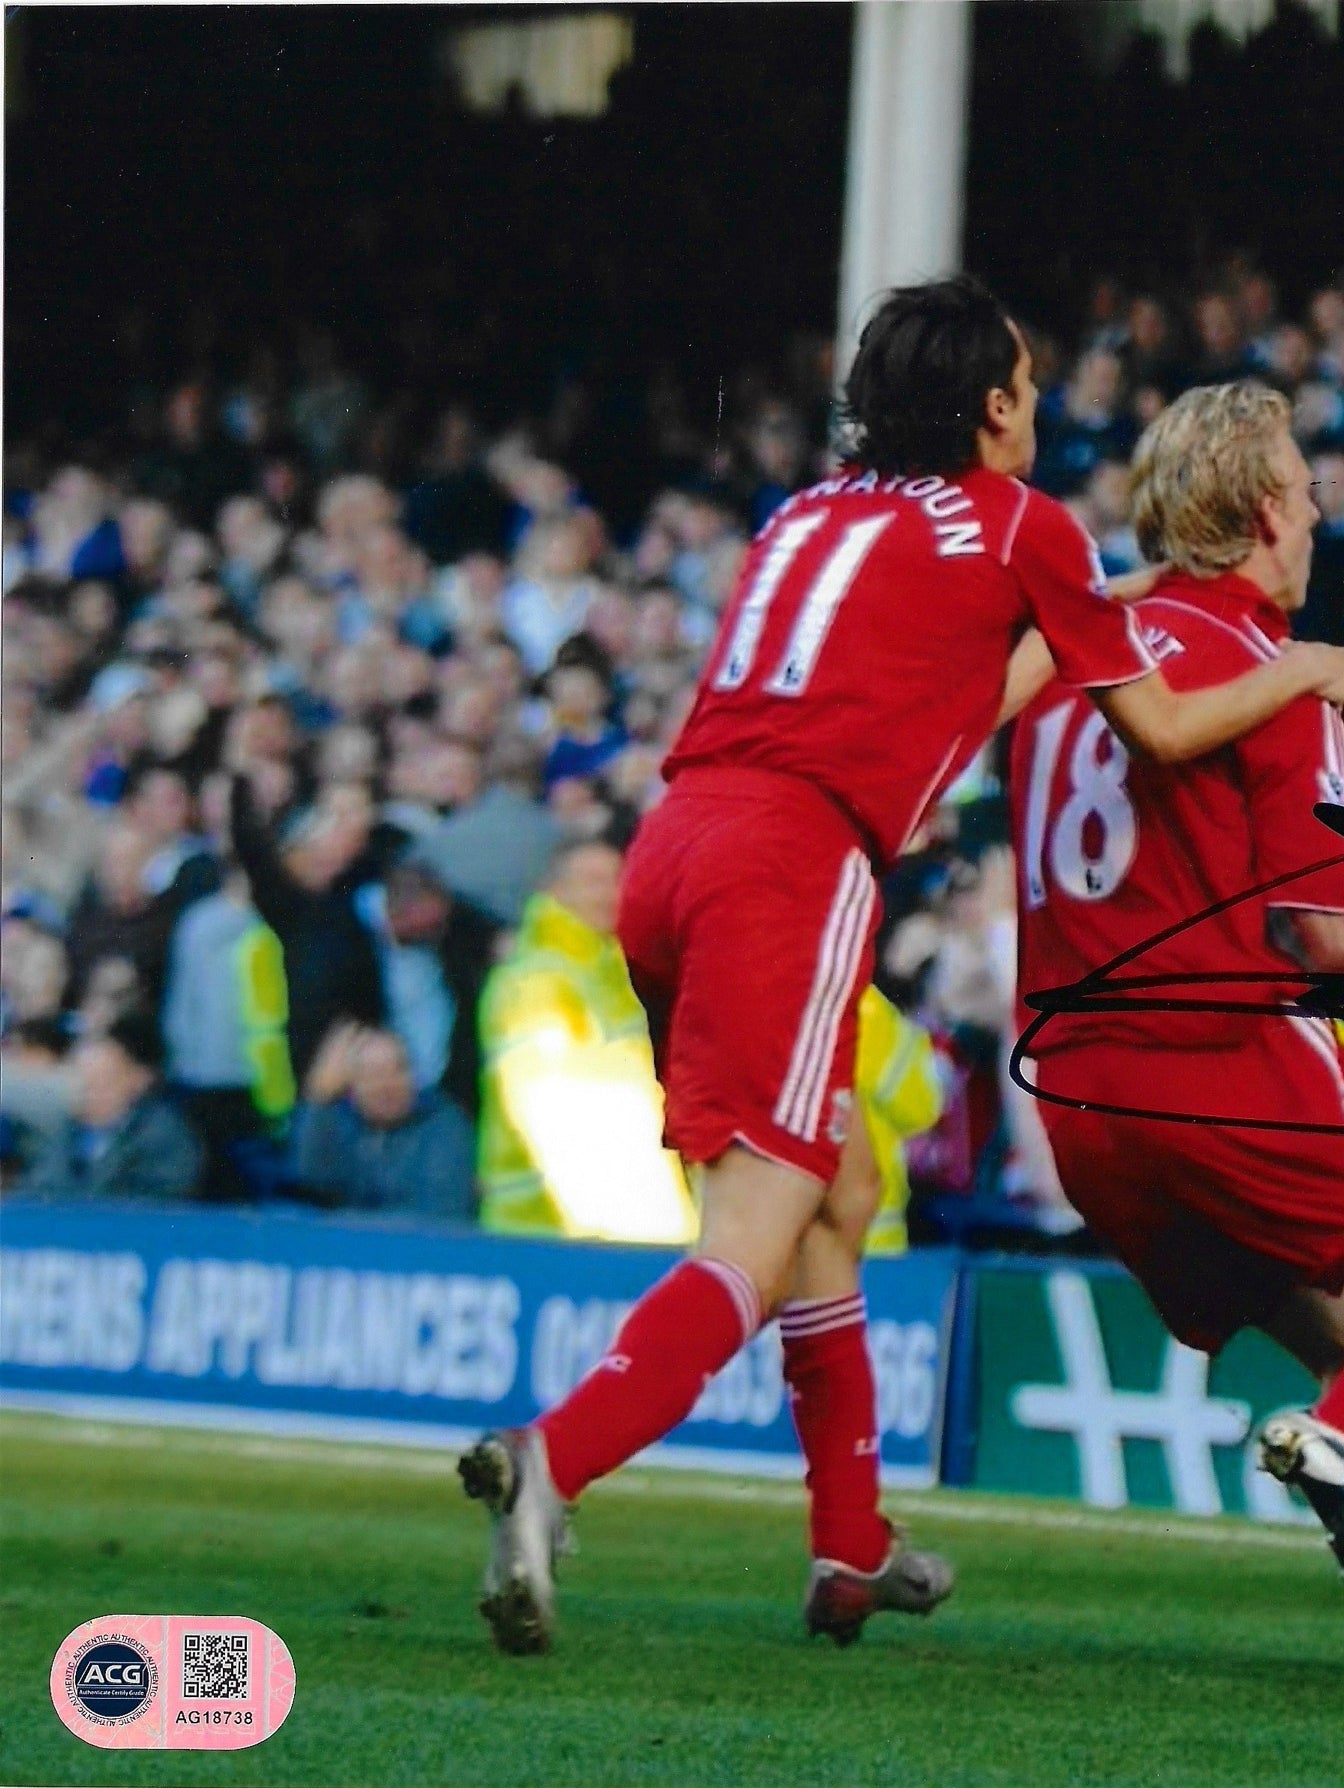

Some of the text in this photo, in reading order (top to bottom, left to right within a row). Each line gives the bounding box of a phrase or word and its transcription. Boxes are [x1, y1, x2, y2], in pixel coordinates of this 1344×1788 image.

[708, 507, 898, 698] 11
[1026, 698, 1140, 910] 18
[145, 1256, 521, 1403] APPLIANCES
